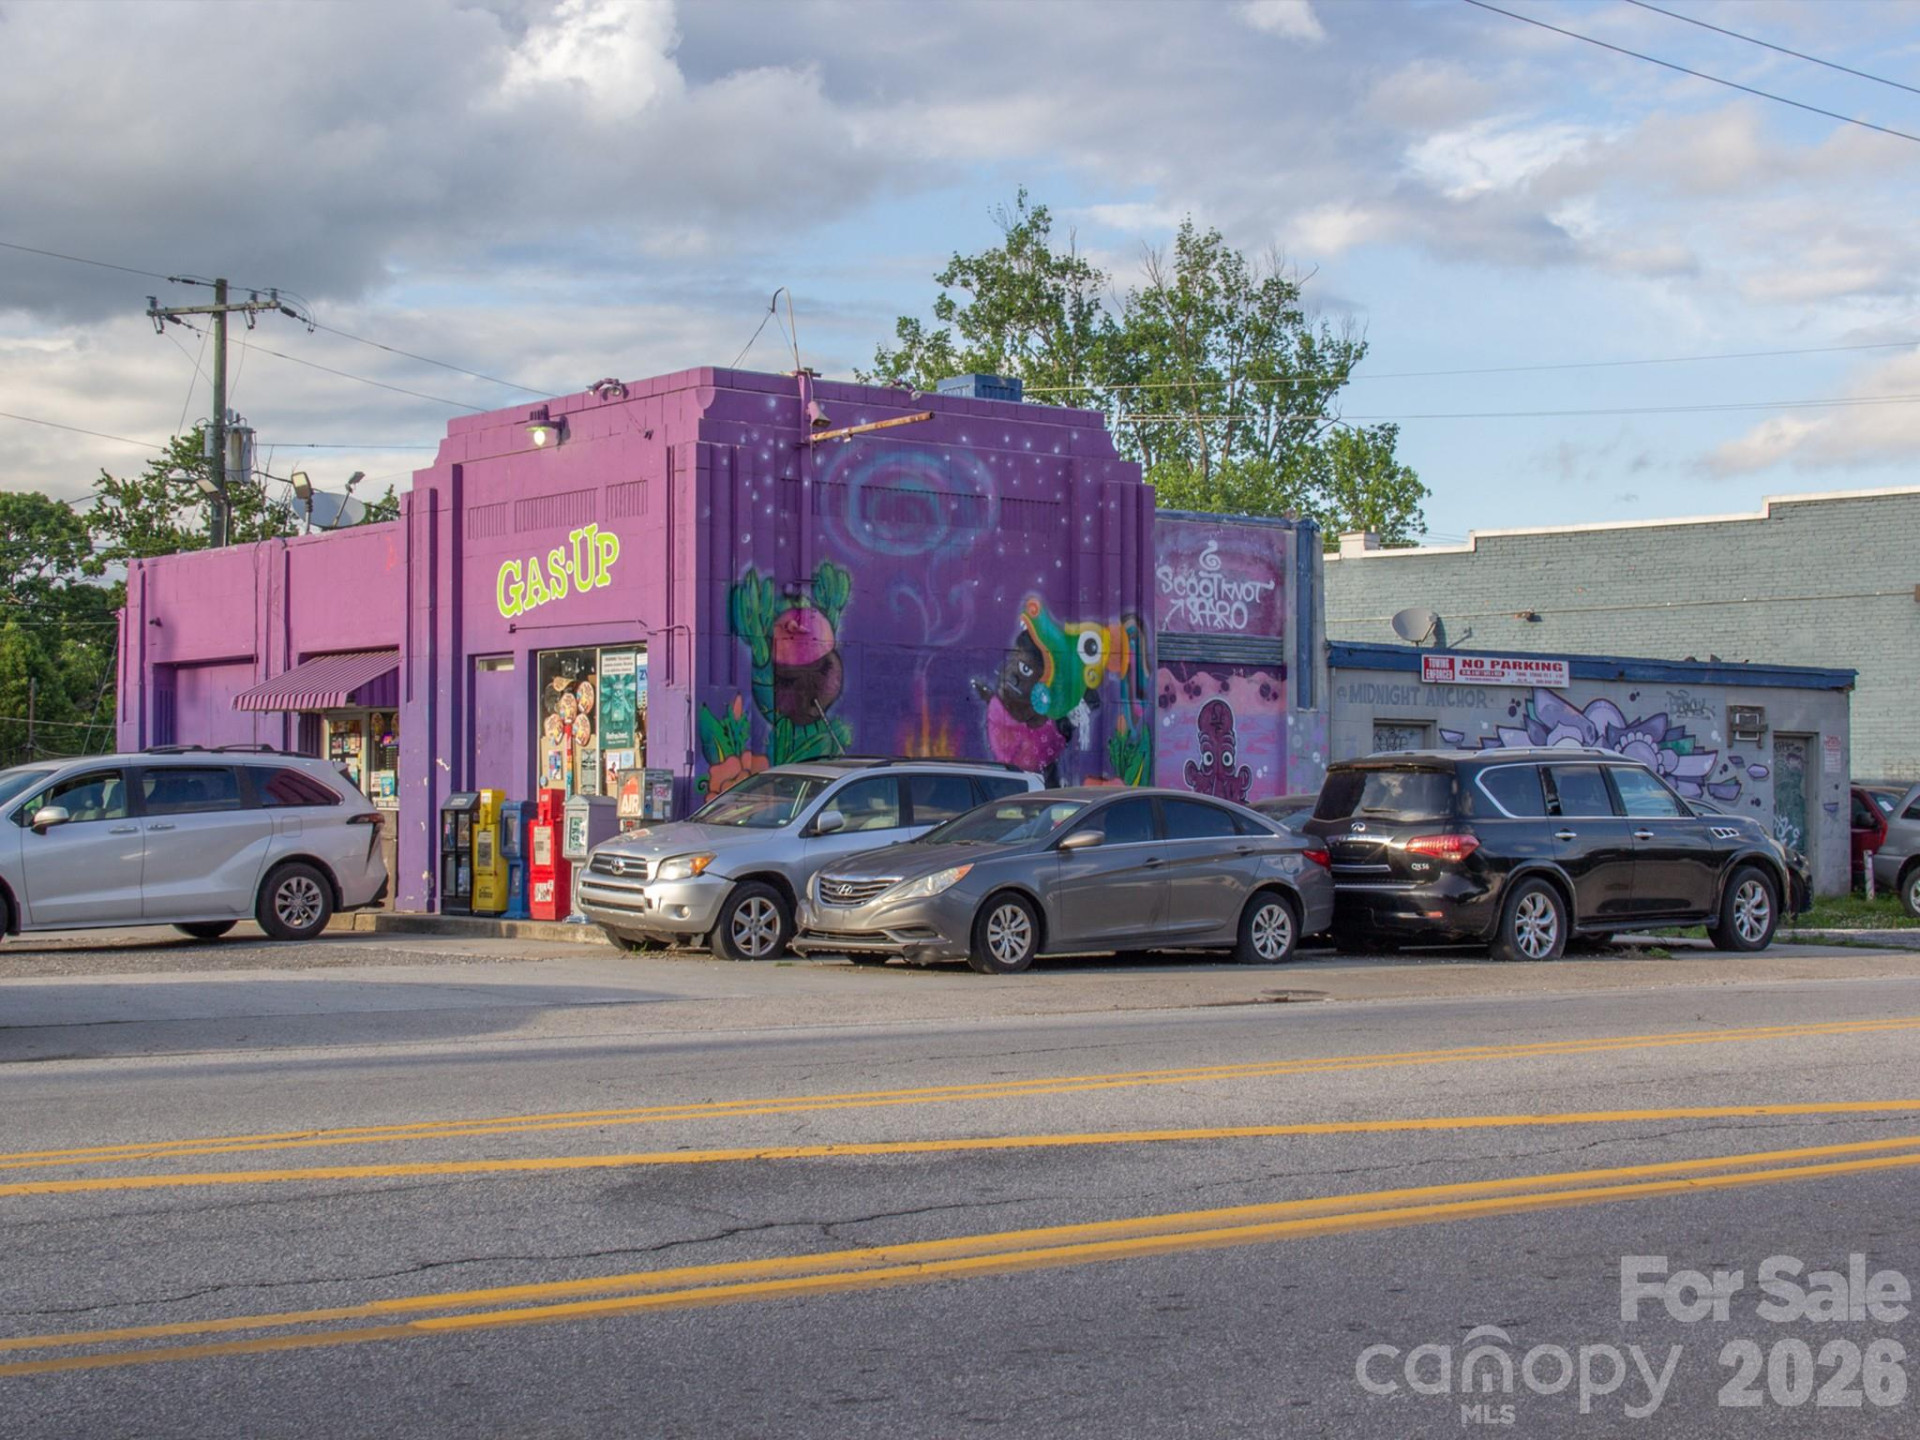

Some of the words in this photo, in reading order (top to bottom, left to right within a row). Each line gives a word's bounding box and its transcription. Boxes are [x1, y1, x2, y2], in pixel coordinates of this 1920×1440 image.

[1462, 659, 1485, 669] NO
[1490, 660, 1563, 672] PARKING
[1425, 687, 1489, 709] ANCHOR
[621, 794, 641, 815] AIR
